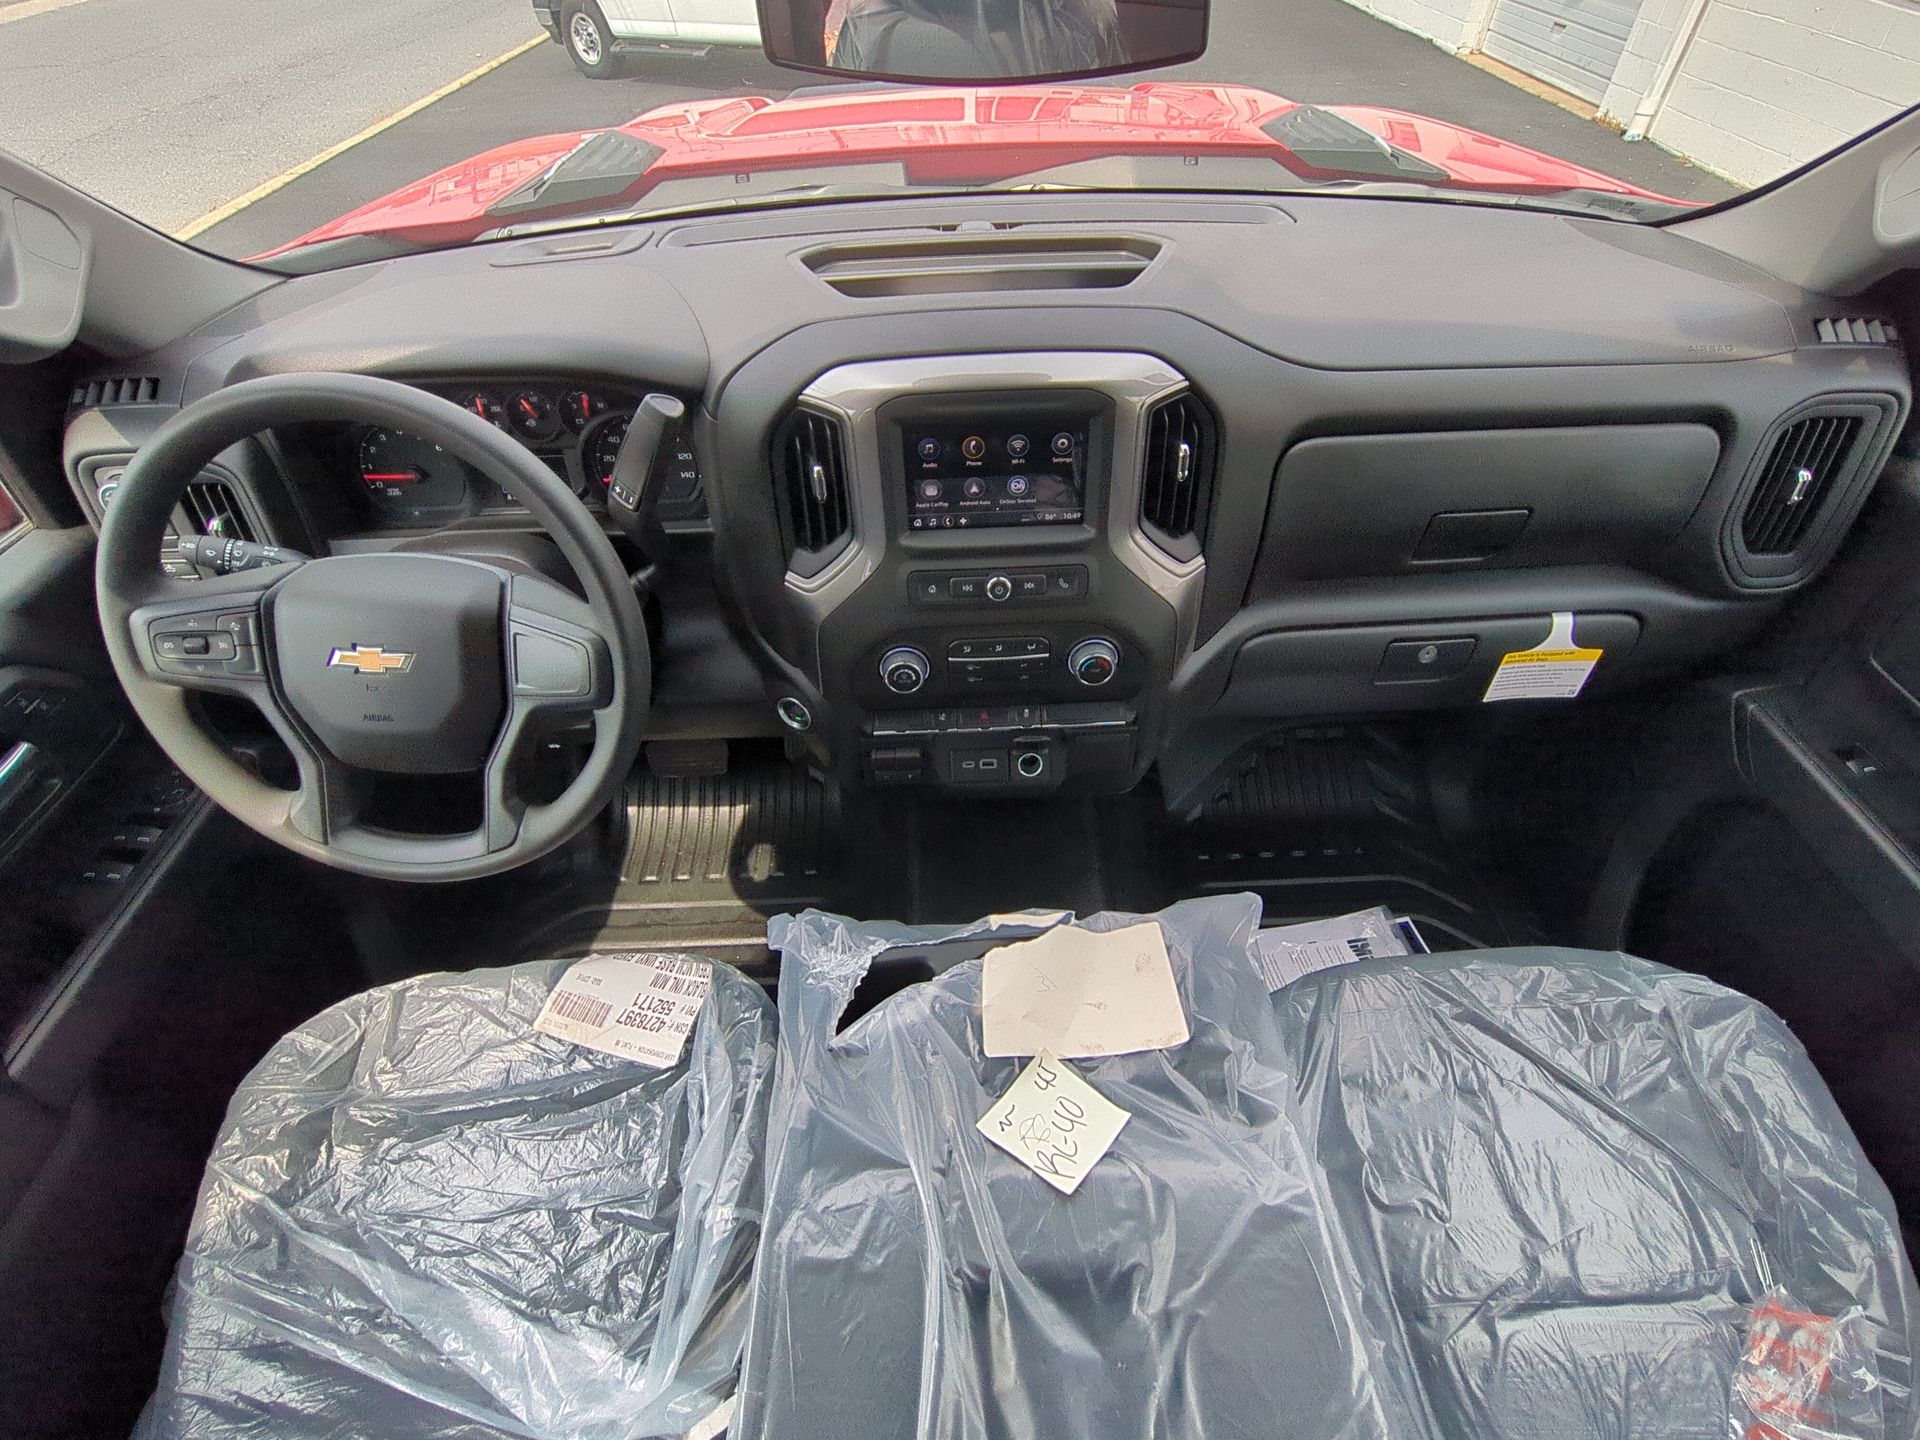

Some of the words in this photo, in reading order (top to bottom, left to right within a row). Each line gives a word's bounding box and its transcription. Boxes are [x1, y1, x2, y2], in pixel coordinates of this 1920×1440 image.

[1688, 344, 1736, 353] AIRBAG
[680, 471, 695, 479] 140
[668, 977, 686, 995] VNL
[682, 980, 708, 999] BLACK
[632, 993, 676, 1016] 552171
[616, 1008, 667, 1033] 4278397
